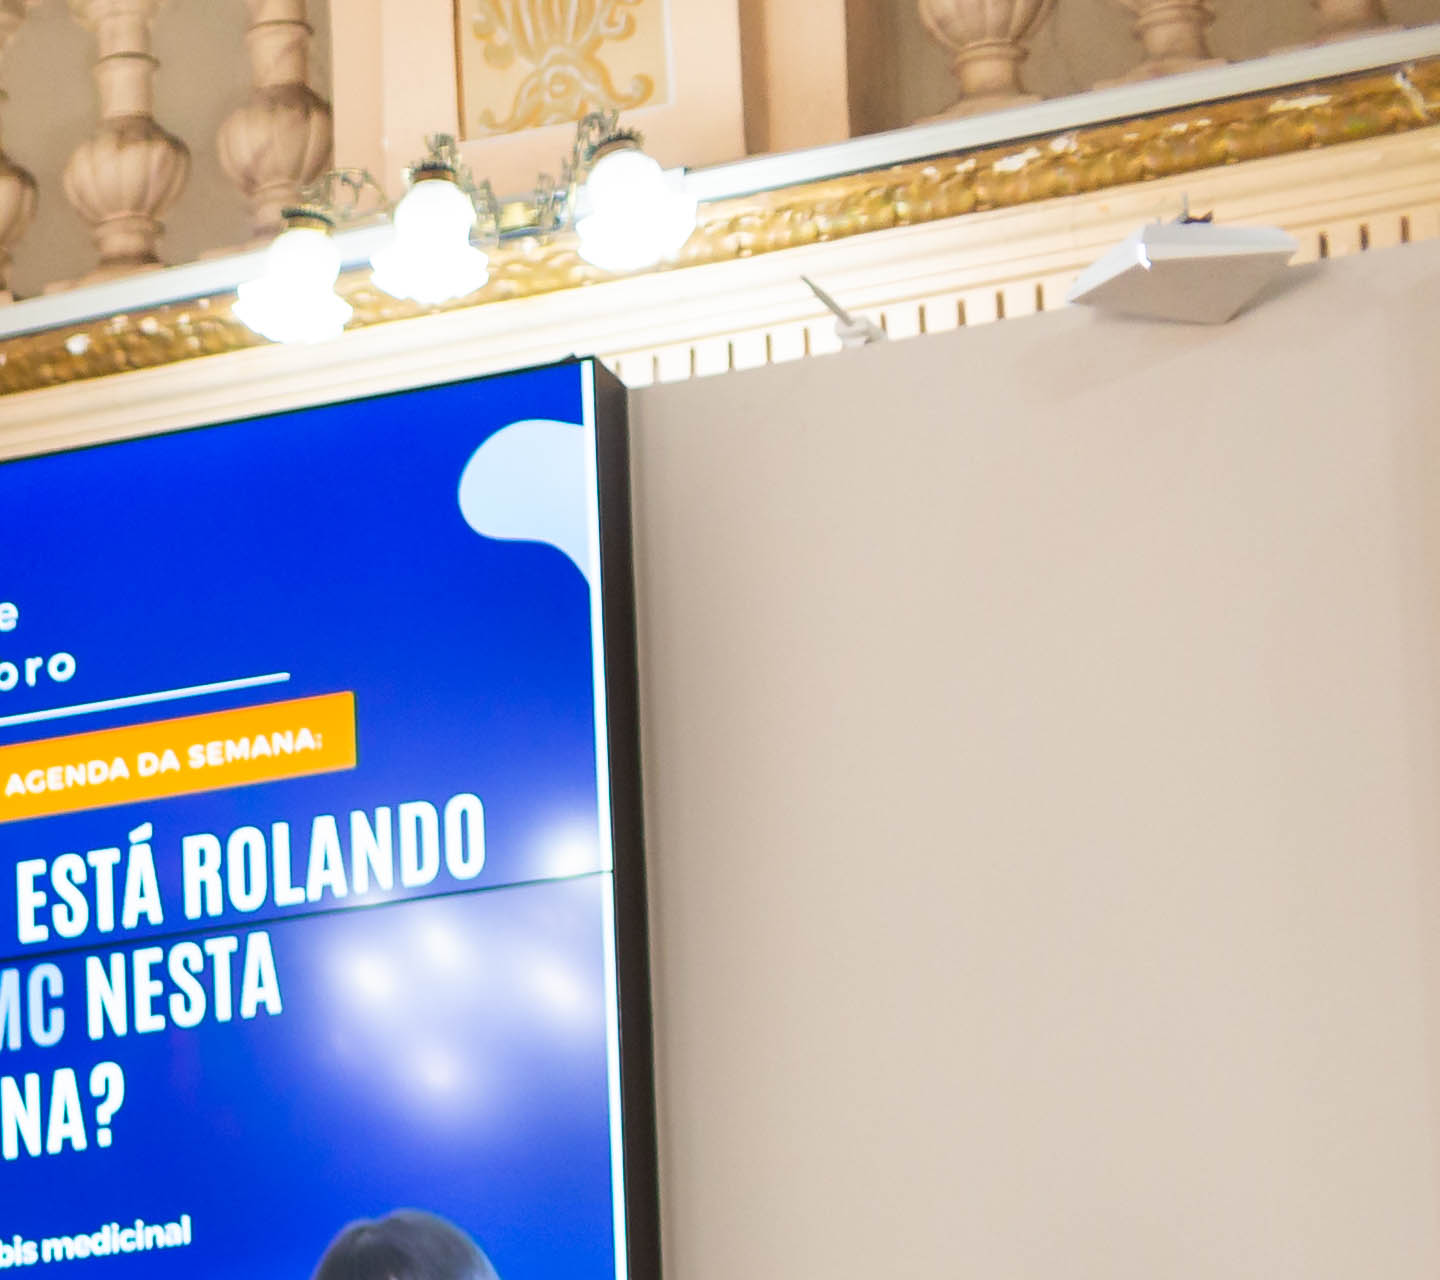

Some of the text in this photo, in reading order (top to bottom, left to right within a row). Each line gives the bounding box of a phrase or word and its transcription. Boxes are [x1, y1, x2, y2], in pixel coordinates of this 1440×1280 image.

[6, 756, 129, 797] AGENDA
[138, 750, 180, 777] DA
[17, 822, 162, 944] ESTÁ
[181, 792, 487, 919] ROLANDO
[87, 932, 281, 1041] NESTA
[41, 1216, 193, 1262] medicinal
